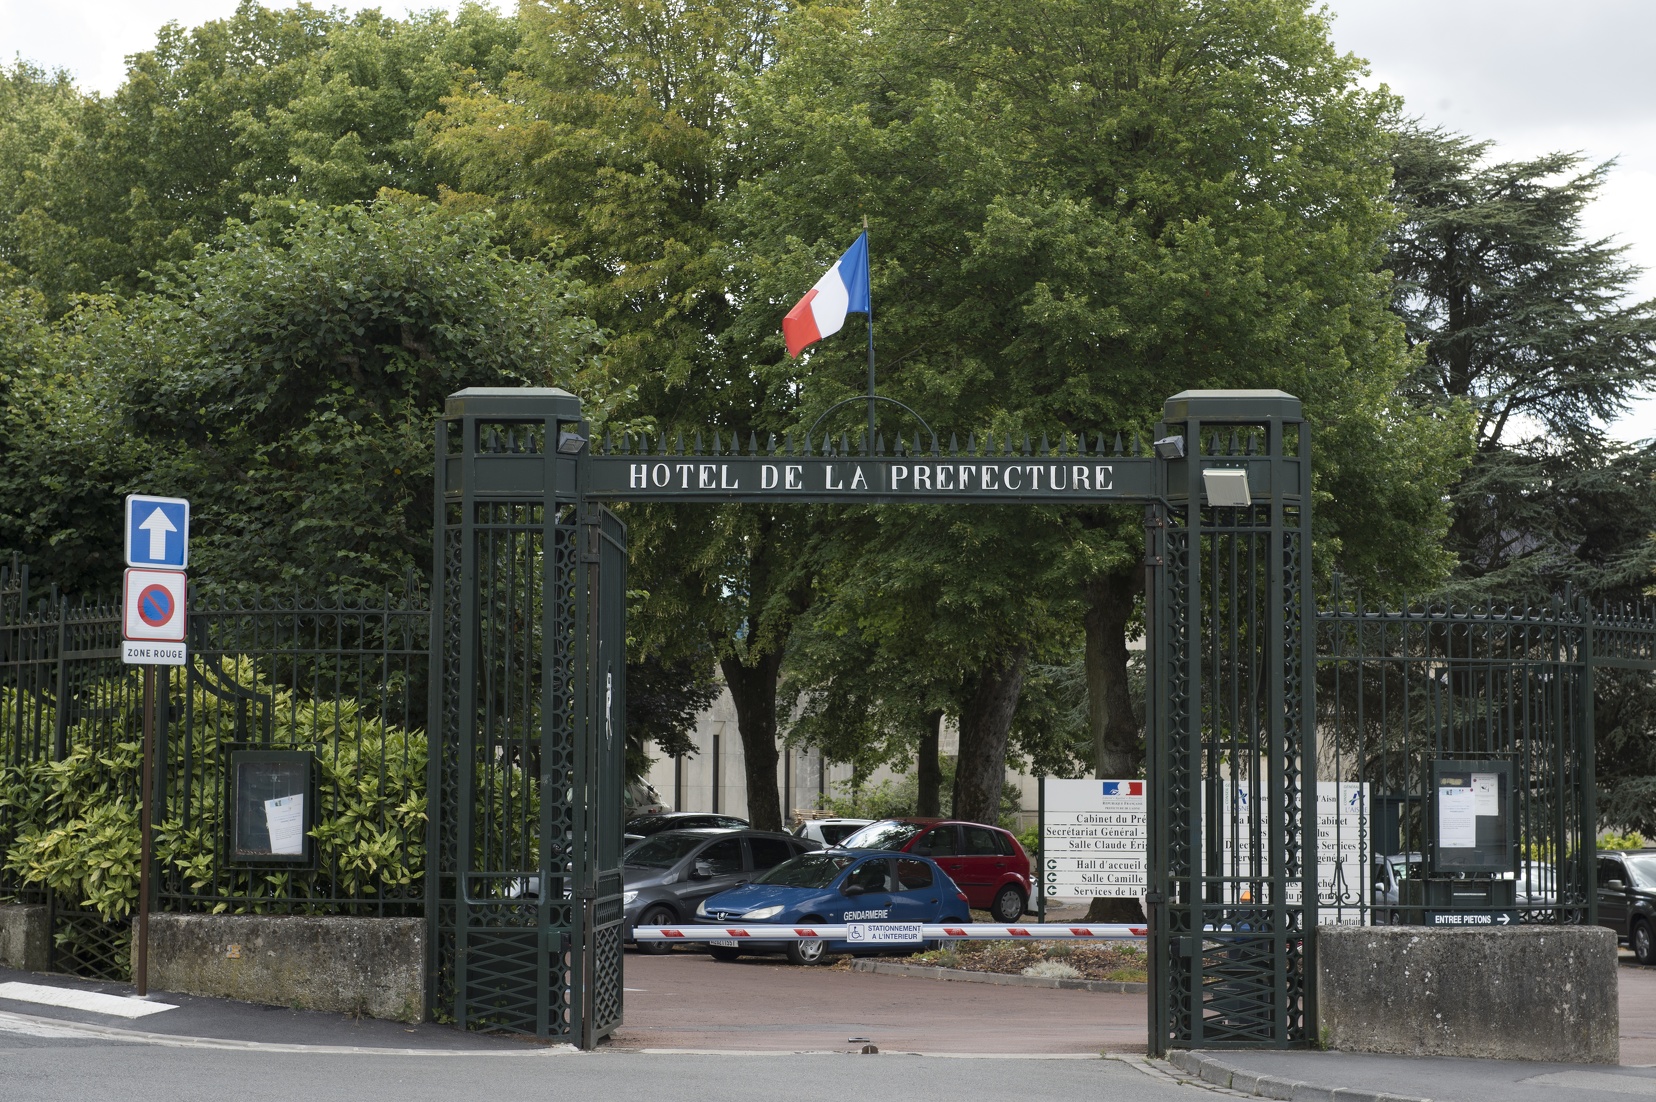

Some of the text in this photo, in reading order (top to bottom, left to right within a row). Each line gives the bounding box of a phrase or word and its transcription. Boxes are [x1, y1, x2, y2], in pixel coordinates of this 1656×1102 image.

[629, 463, 1113, 491] HOTEL DE LA PREFECTURE
[127, 648, 183, 659] ZONE ROUGE
[1076, 813, 1147, 824] Cabinet du Pré
[1046, 827, 1097, 836] Secrétariat
[1100, 827, 1138, 837] Général
[1068, 840, 1092, 849] Salle
[1094, 840, 1127, 849] Claude
[1321, 841, 1356, 850] Serices
[1316, 853, 1348, 863] généal
[1076, 859, 1096, 869] Hall
[1099, 860, 1141, 870] d'accueil
[1081, 873, 1143, 883] Salle Camille
[1073, 886, 1112, 896] Services
[1115, 887, 1126, 896] de
[1129, 887, 1137, 896] la
[843, 909, 889, 921] GENDARMERIE
[1435, 915, 1492, 924] ENTREE PIETONS
